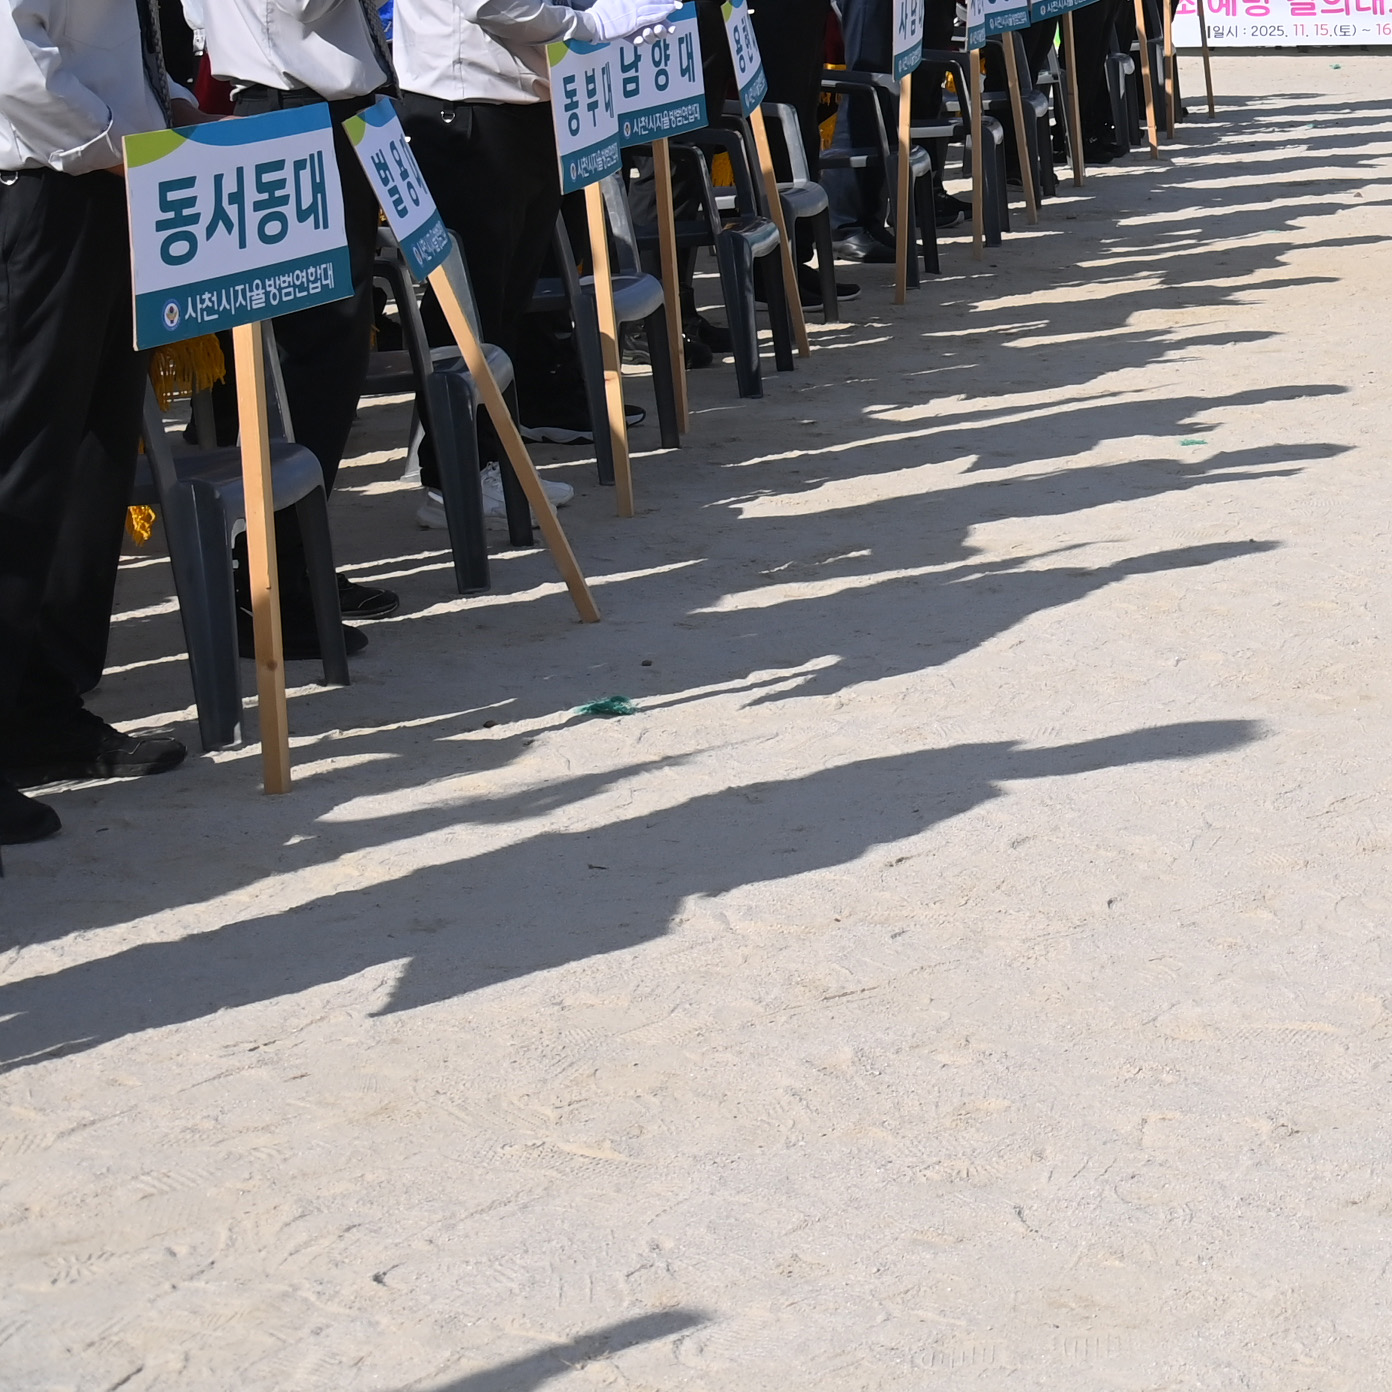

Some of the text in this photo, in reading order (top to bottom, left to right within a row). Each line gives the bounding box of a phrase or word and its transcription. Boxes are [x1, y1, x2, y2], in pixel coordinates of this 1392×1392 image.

[620, 31, 696, 99] 남양대
[1213, 25, 1238, 38] 일시
[1251, 25, 1288, 38] 2025.
[1293, 24, 1309, 37] 11.
[1314, 24, 1357, 38] 15.(토)
[562, 61, 614, 137] 동부대
[155, 150, 329, 266] 동서동대
[184, 262, 336, 324] 사천시자율방범연합대
